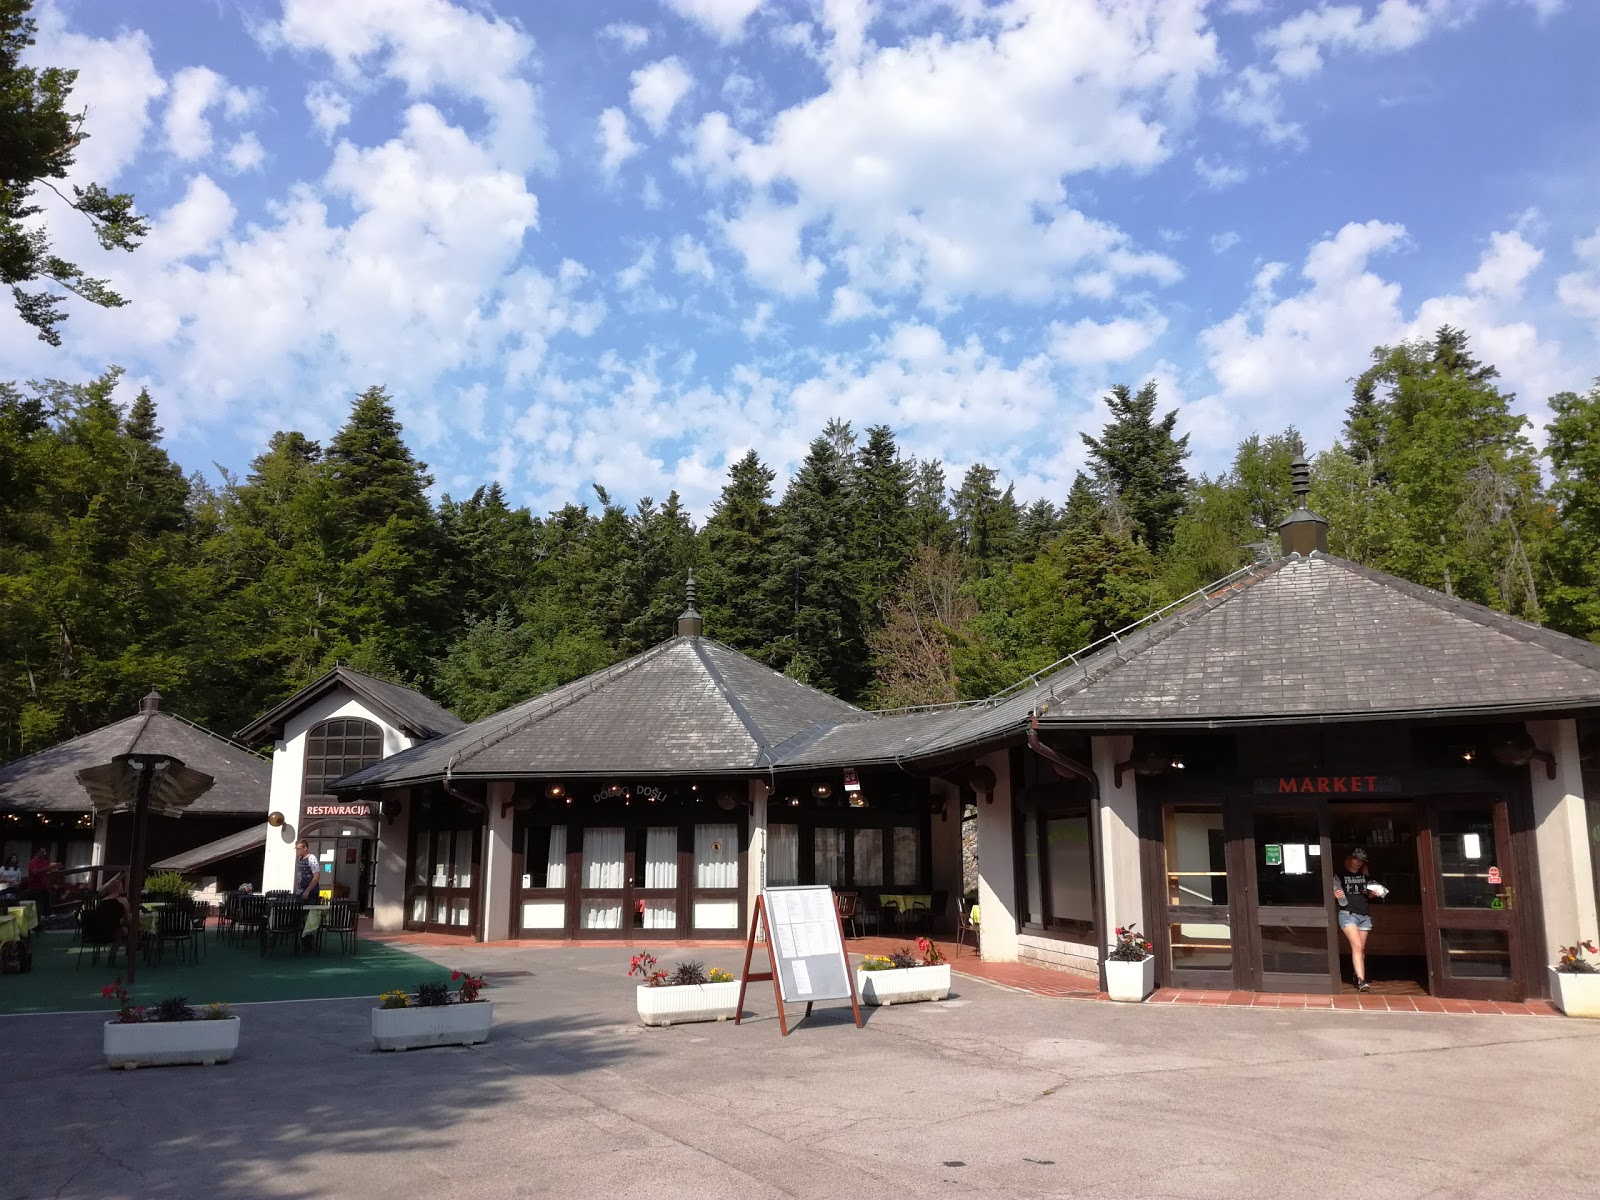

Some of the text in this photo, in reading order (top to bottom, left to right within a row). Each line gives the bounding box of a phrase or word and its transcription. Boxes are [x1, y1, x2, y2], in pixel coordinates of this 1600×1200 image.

[1279, 776, 1377, 793] MARKET
[636, 785, 667, 803] DOŠLI
[306, 805, 371, 816] RESTAVRACIJA
